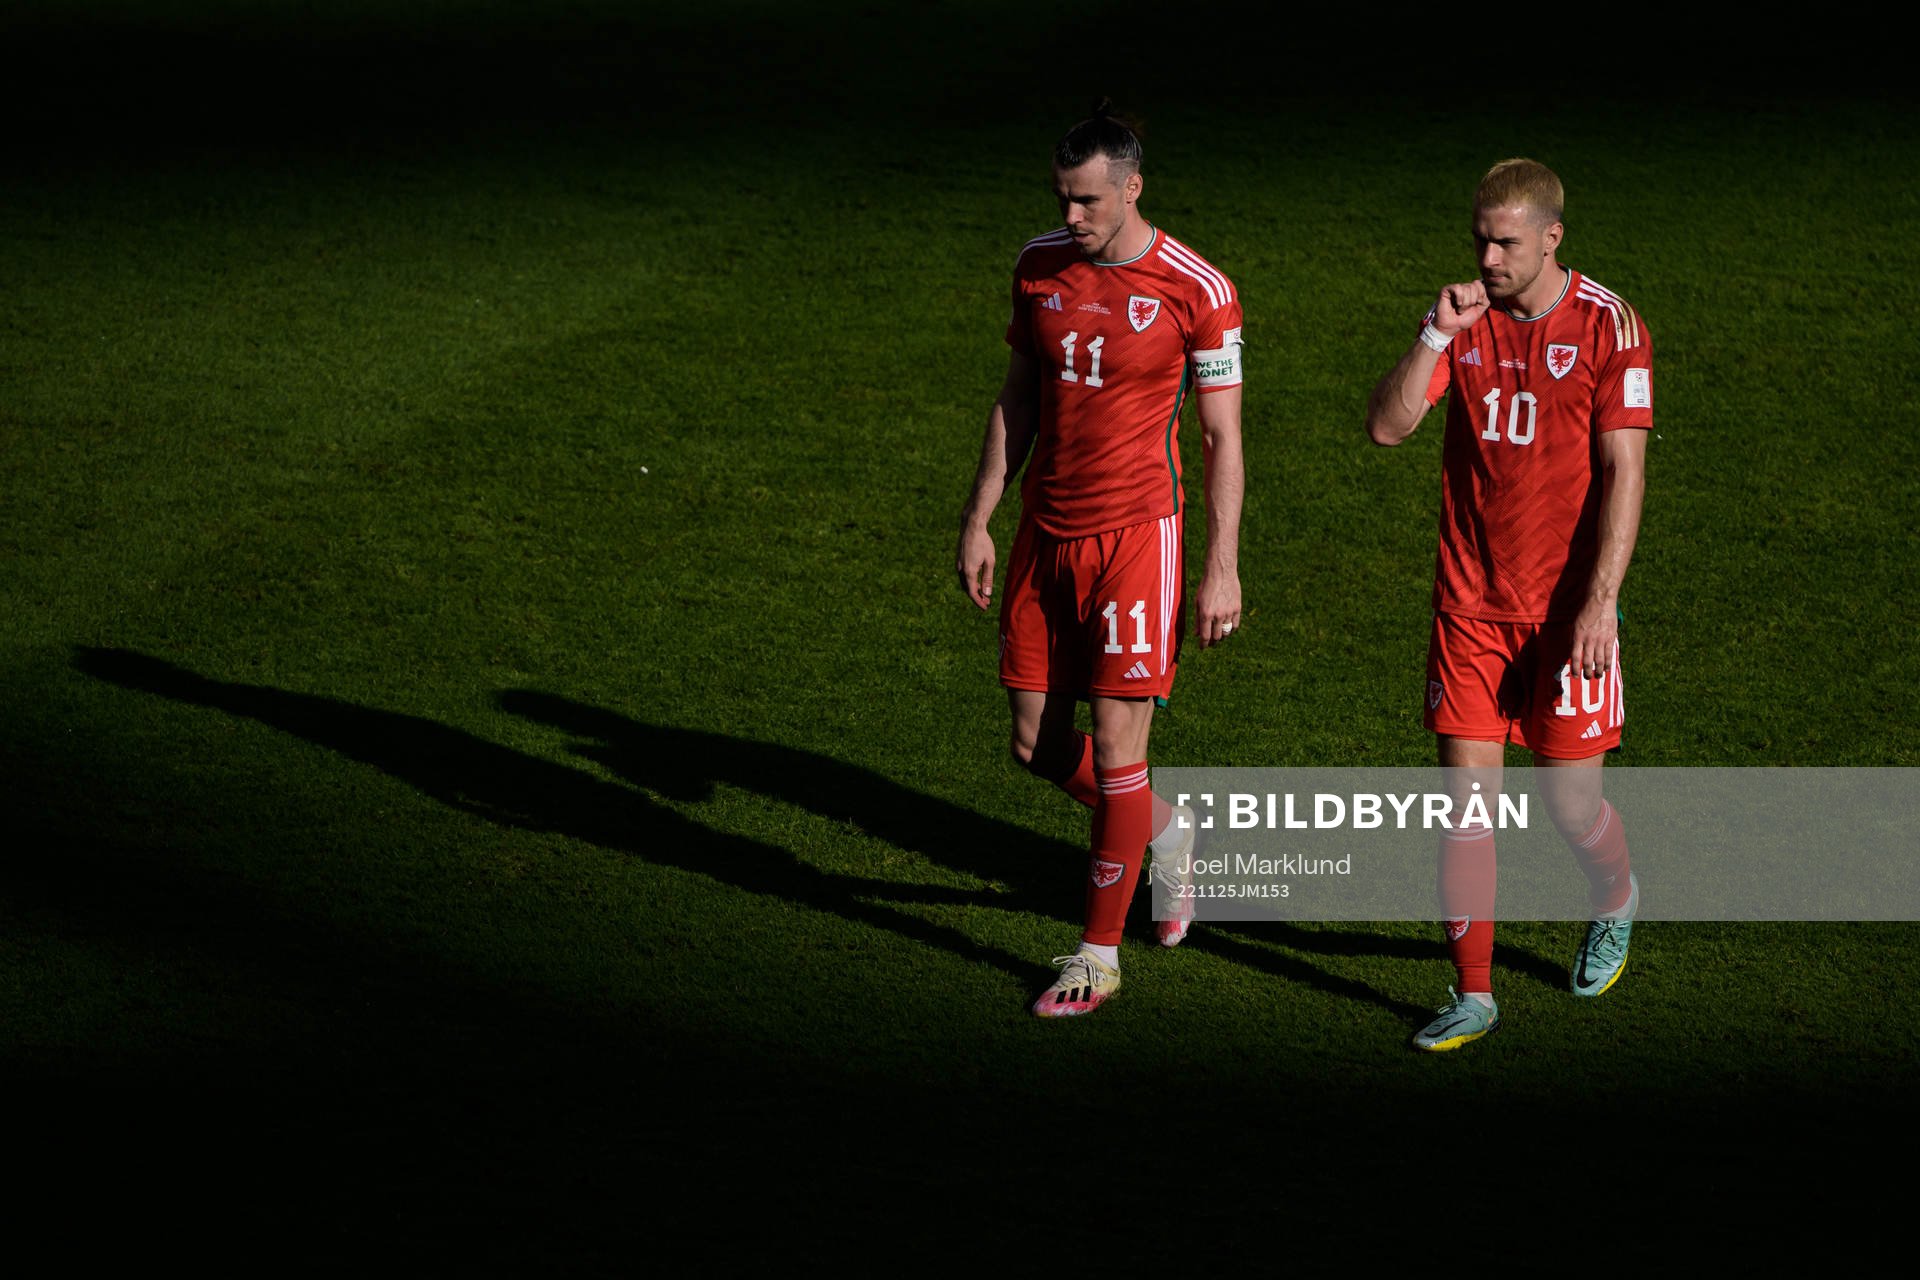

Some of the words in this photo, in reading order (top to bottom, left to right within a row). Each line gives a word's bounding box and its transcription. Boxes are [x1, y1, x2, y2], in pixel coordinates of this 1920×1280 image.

[1061, 331, 1104, 387] 11
[1192, 361, 1213, 369] AVE
[1215, 358, 1233, 367] THE
[1192, 366, 1233, 378] LANET
[1481, 387, 1537, 445] 10
[1102, 600, 1152, 654] 11
[1554, 661, 1606, 716] 10
